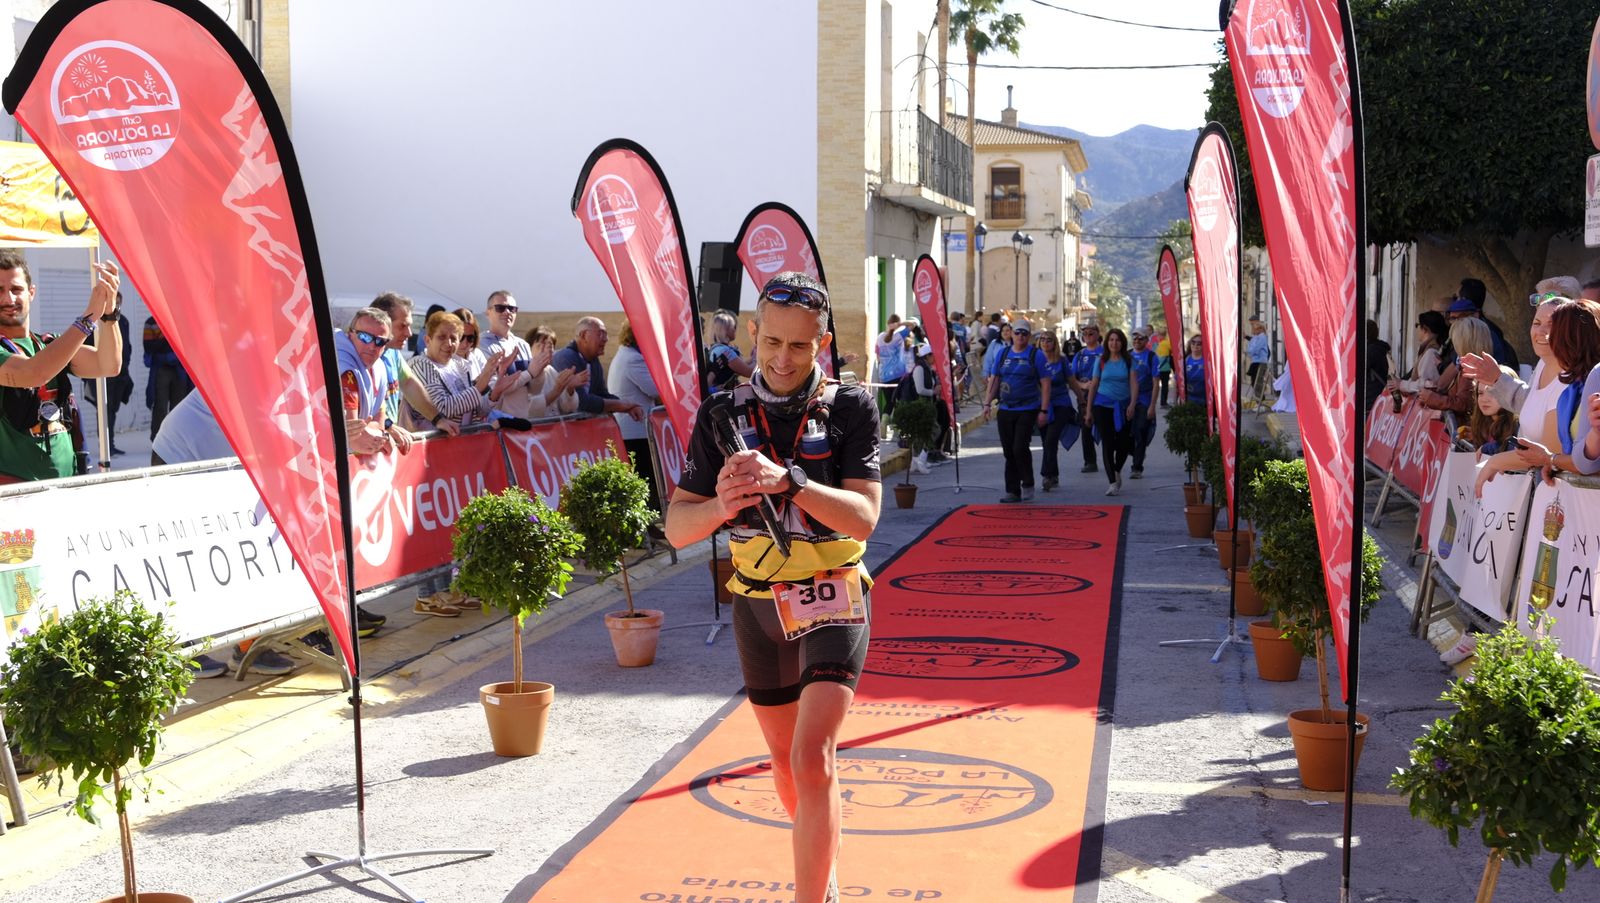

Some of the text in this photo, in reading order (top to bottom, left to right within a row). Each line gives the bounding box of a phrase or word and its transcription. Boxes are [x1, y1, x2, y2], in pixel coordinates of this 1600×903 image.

[66, 508, 259, 559] AYUNTAMIENTO
[72, 536, 296, 612] CANTORI
[798, 582, 837, 606] 30
[851, 702, 960, 711] Cantor
[960, 770, 1010, 780] LA
[680, 877, 943, 901] de Cntoria
